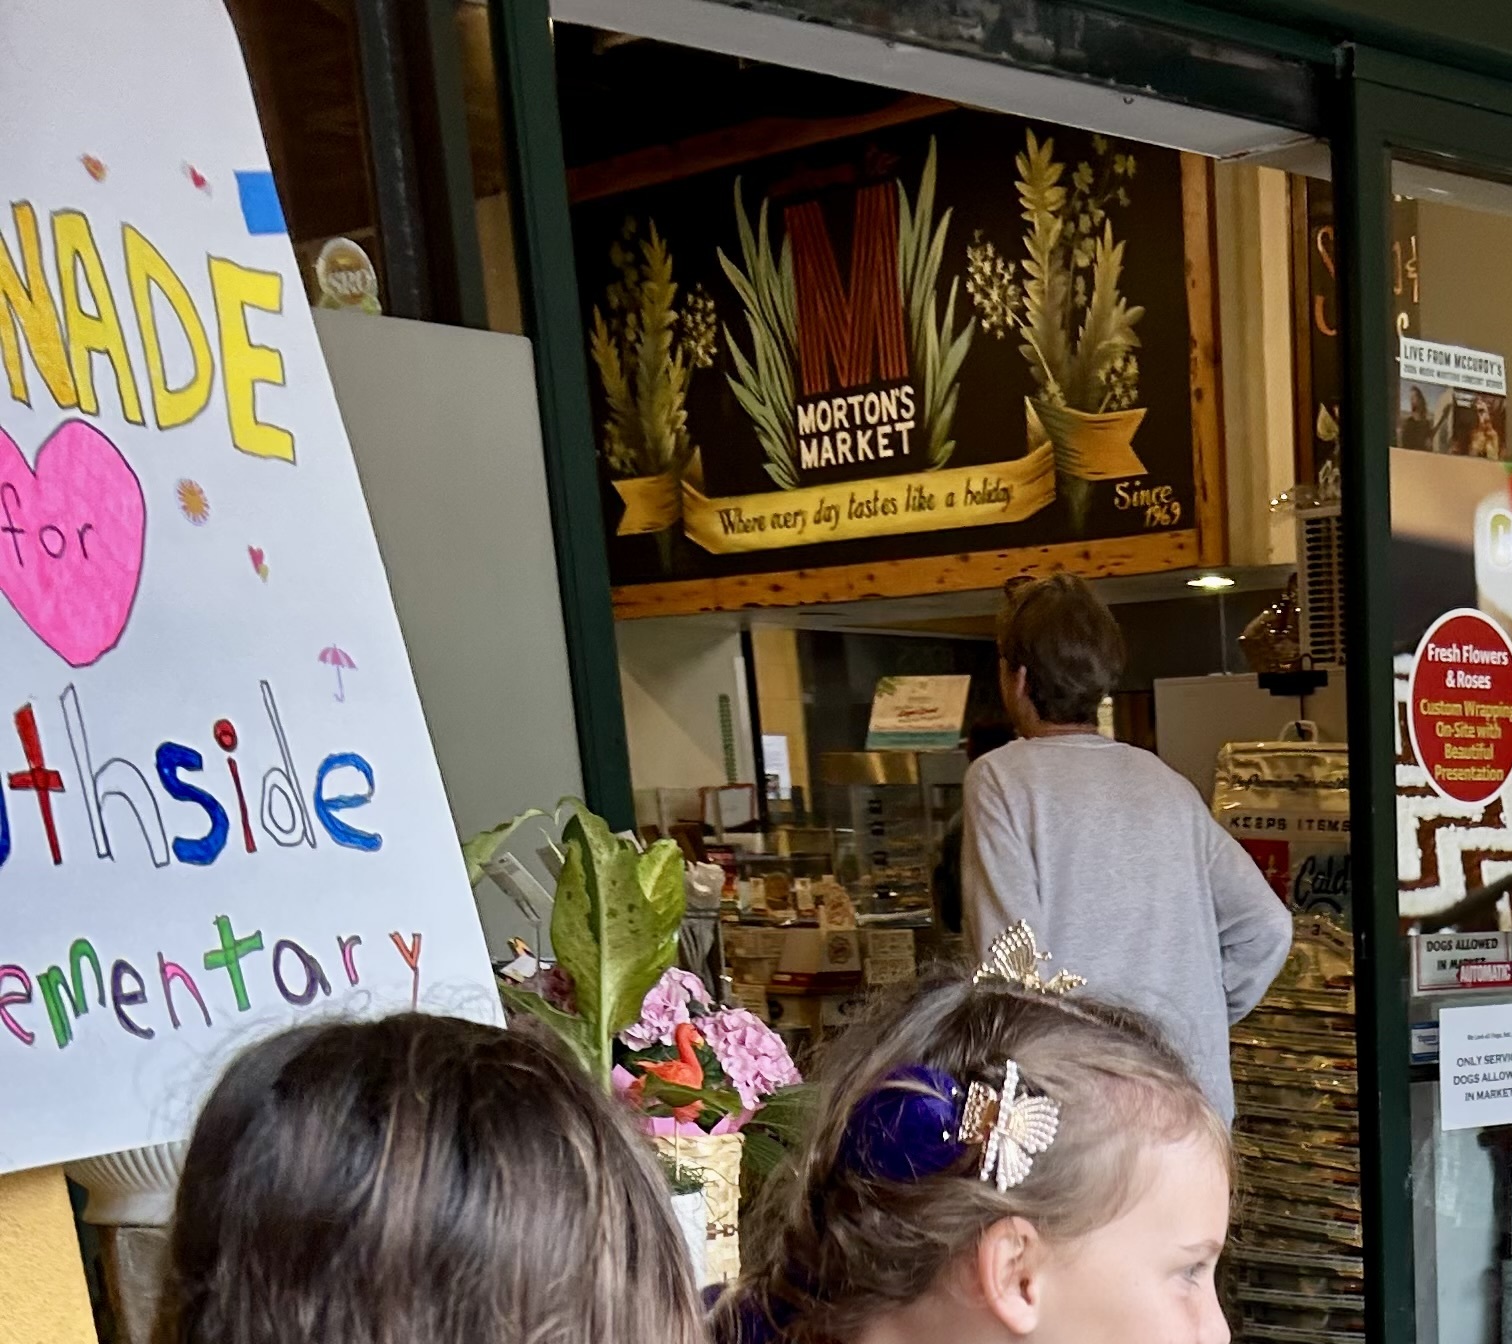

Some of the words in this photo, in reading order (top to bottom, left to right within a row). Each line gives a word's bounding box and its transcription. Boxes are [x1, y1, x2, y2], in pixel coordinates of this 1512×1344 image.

[1404, 344, 1424, 361] LIVE
[1427, 348, 1451, 366] FROM
[797, 385, 915, 435] MORTON'S
[800, 420, 915, 470] MARKET
[1114, 481, 1172, 510] Since
[717, 507, 765, 536] Where
[770, 508, 808, 534] every
[813, 497, 840, 530] day
[848, 489, 898, 520] tastes
[905, 484, 935, 512] like
[944, 491, 955, 507] a
[963, 477, 1014, 513] holiday
[0, 481, 95, 567] for
[1427, 643, 1461, 663] Fresh
[1462, 644, 1509, 666] Flowers
[1446, 670, 1456, 688] &
[1457, 670, 1491, 690] Roses
[1419, 698, 1462, 716] Custom
[1436, 721, 1476, 738] On-Site
[1477, 722, 1502, 739] with
[1444, 743, 1494, 760] Beautiful
[0, 680, 383, 868] thside
[1434, 764, 1504, 782] Presentation
[1229, 815, 1288, 831] KEEPS
[1297, 818, 1350, 832] ITEMS
[1427, 939, 1453, 952] DOGS
[1456, 937, 1498, 951] ALLOWED
[1437, 959, 1446, 970] IN
[1460, 963, 1511, 983] AUTOMATIC
[1456, 1055, 1482, 1067] ONLY
[1453, 1073, 1480, 1085] DOGS
[1464, 1090, 1475, 1101] IN
